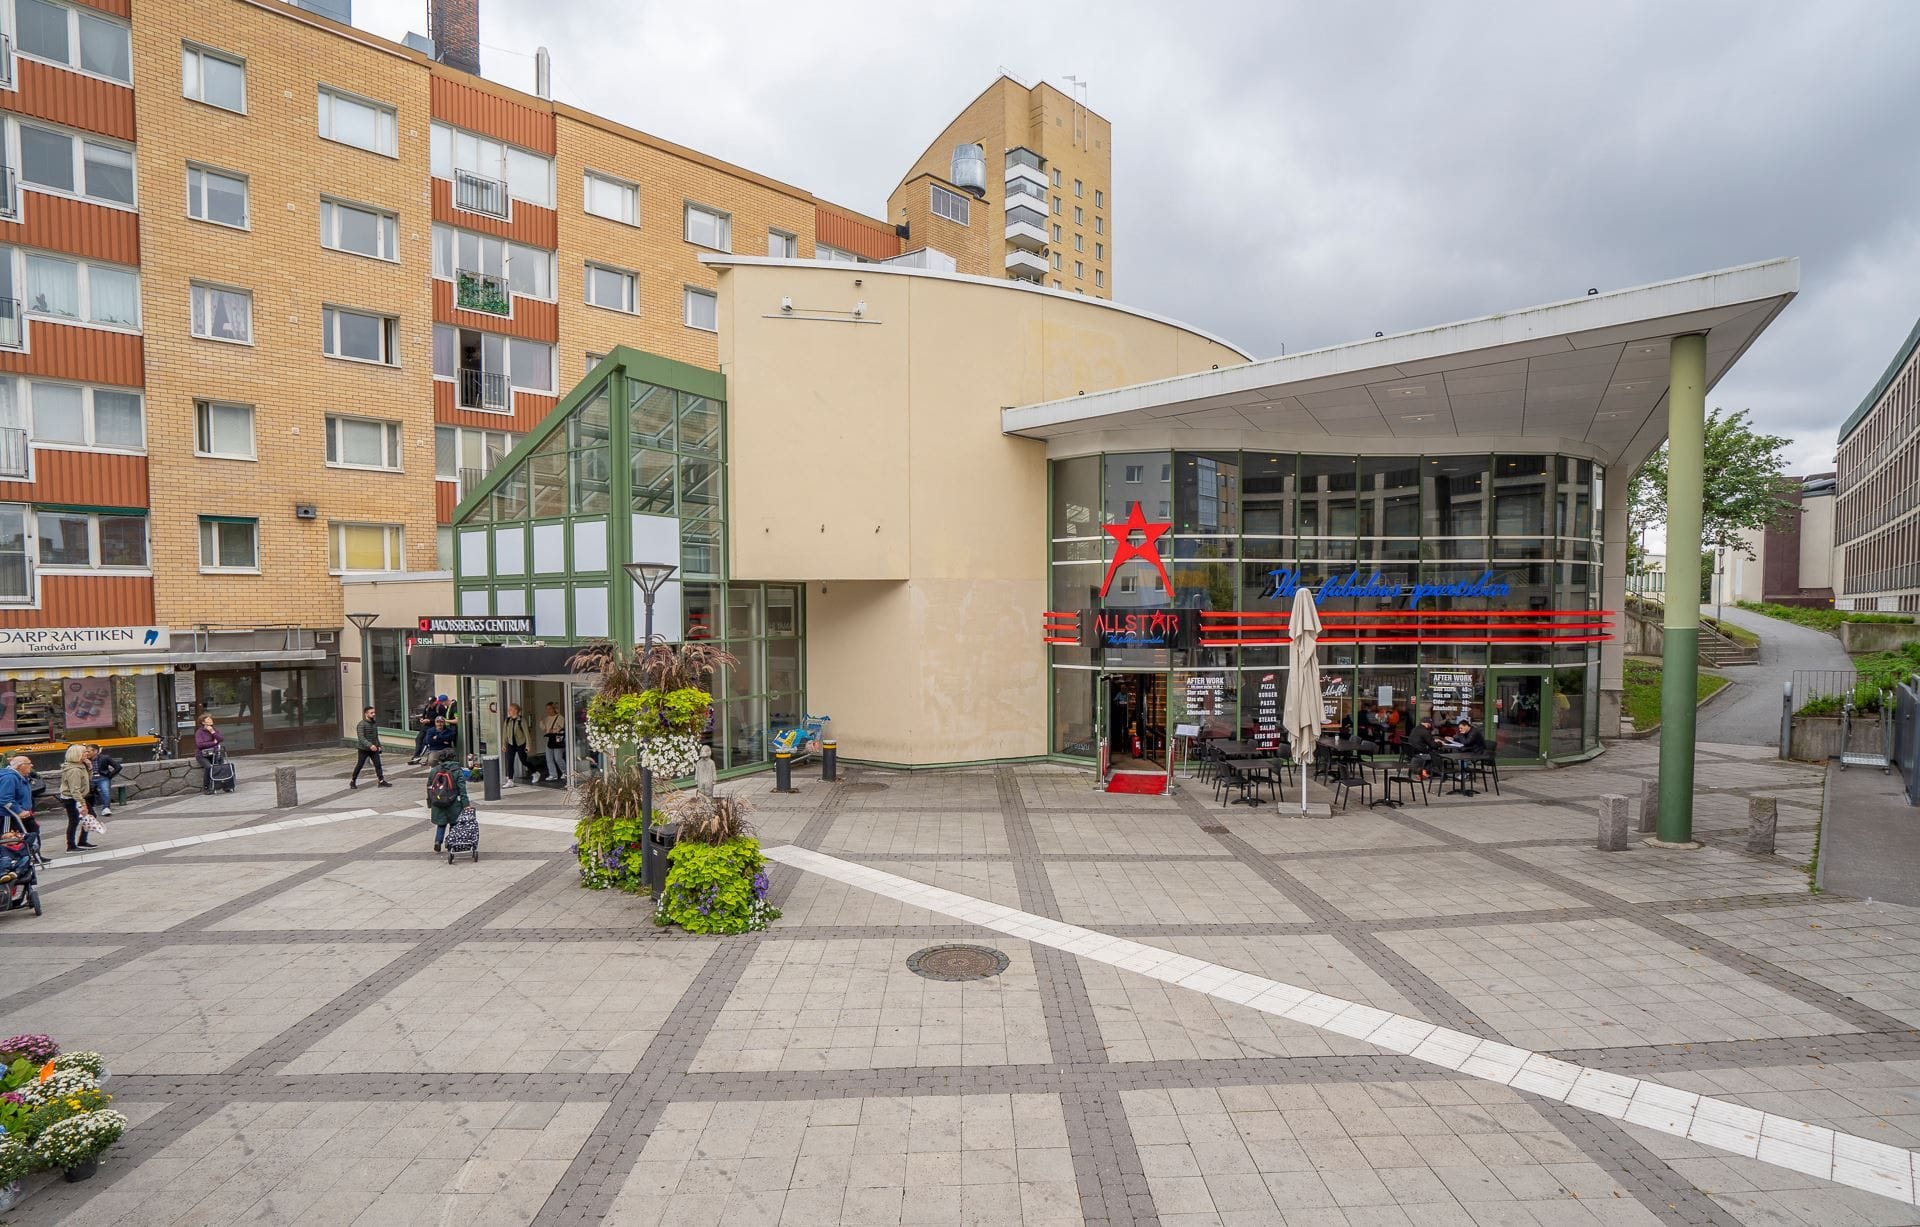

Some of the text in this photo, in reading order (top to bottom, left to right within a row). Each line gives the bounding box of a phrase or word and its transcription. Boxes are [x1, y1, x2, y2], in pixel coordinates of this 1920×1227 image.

[1315, 569, 1402, 605] fabulous
[1409, 569, 1511, 609] sportsbar
[430, 619, 530, 631] JAKOBSBERGS CENTRUM
[1094, 610, 1179, 632] ALLSTAR
[28, 643, 77, 652] Tandvård
[1187, 677, 1224, 685] AFTER WORK
[1433, 674, 1472, 683] AFTER WORK
